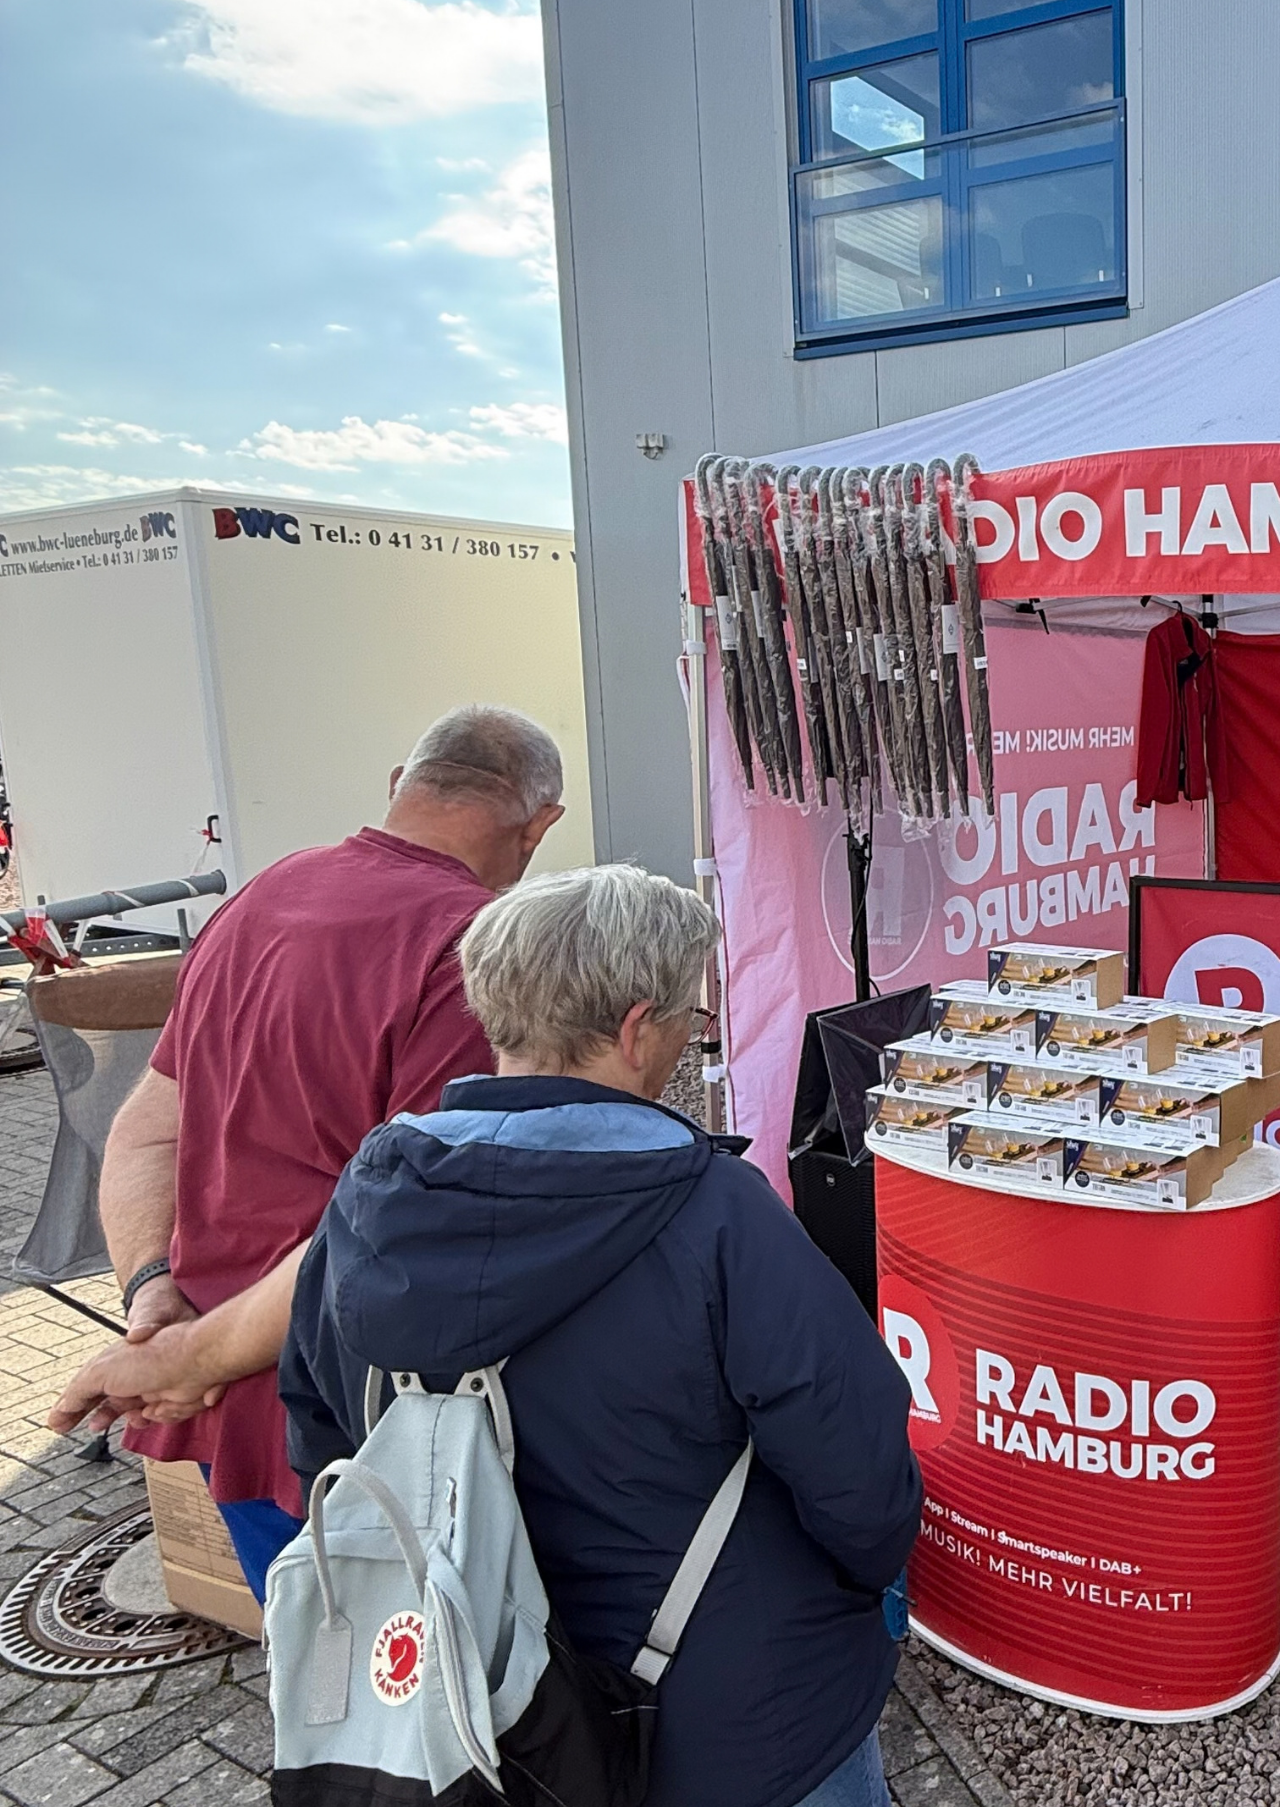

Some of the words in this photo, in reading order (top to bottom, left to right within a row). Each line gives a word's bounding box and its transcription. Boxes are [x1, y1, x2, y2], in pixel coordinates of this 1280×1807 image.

[11, 523, 139, 556] www.bwc-lueneburg.de
[139, 511, 177, 543] BWC
[212, 507, 300, 544] BWC
[310, 523, 361, 545] Tel.:
[368, 529, 381, 546] 0
[388, 531, 412, 549] 41
[421, 534, 443, 552] 31
[466, 538, 500, 557] 380
[507, 543, 539, 560] 157
[0, 562, 26, 577] ETTEN
[103, 553, 109, 566] 0
[110, 551, 121, 566] 41
[124, 550, 134, 565] 31
[143, 548, 160, 562] 380
[163, 545, 178, 560] 157
[976, 1348, 1217, 1438] RADIO
[977, 1408, 1216, 1481] HAMBURG
[919, 1518, 981, 1566] MUSIK!
[989, 1555, 1053, 1592] MEHR
[1061, 1577, 1192, 1612] VIELFALT!
[924, 1497, 944, 1517] App
[950, 1511, 988, 1537] Stream
[997, 1530, 1088, 1567] Smartspeaker
[1099, 1559, 1142, 1576] DAB+
